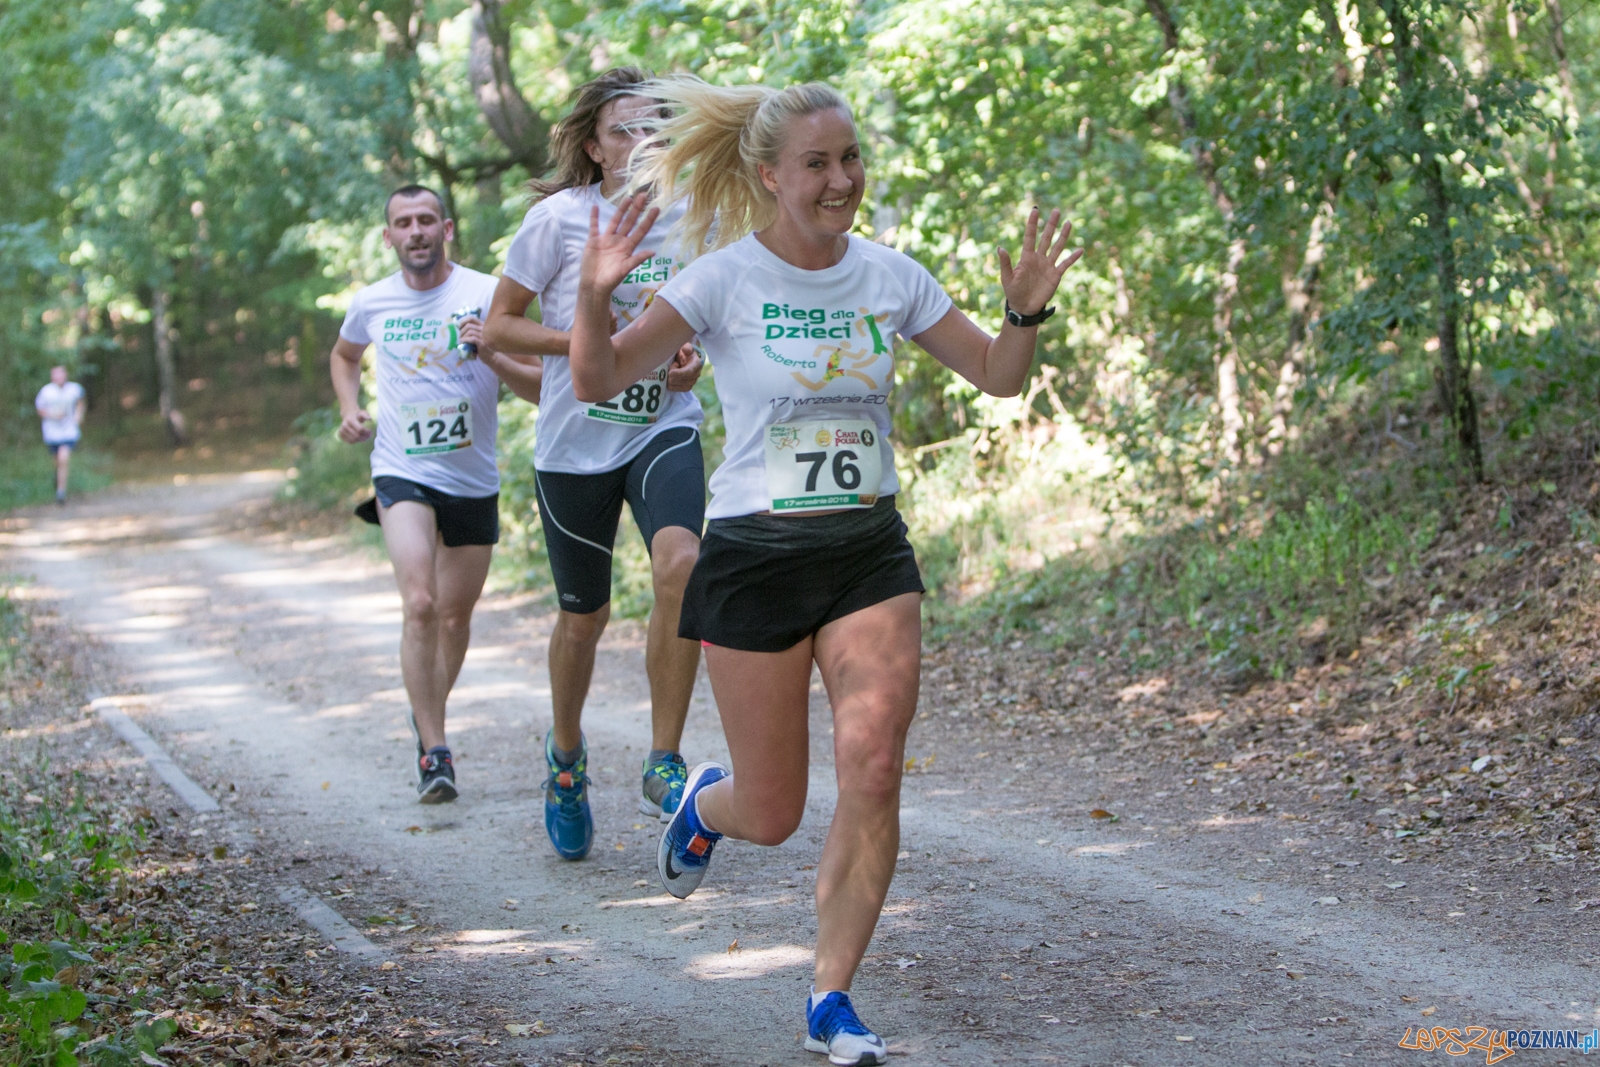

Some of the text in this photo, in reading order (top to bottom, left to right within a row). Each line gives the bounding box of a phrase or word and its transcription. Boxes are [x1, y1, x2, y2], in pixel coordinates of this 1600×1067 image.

[655, 257, 671, 265] dla
[622, 267, 668, 284] zieci
[611, 295, 638, 308] berta
[762, 303, 855, 325] Bieg dla
[384, 317, 442, 330] Bieg dla
[765, 321, 851, 340] Dzieci
[383, 328, 437, 342] Dzieci
[760, 344, 817, 369] Roberta
[595, 384, 662, 413] 88
[769, 397, 790, 410] 17
[863, 394, 888, 405] 20
[408, 415, 468, 445] 124
[795, 450, 861, 492] 76
[784, 499, 795, 507] 17
